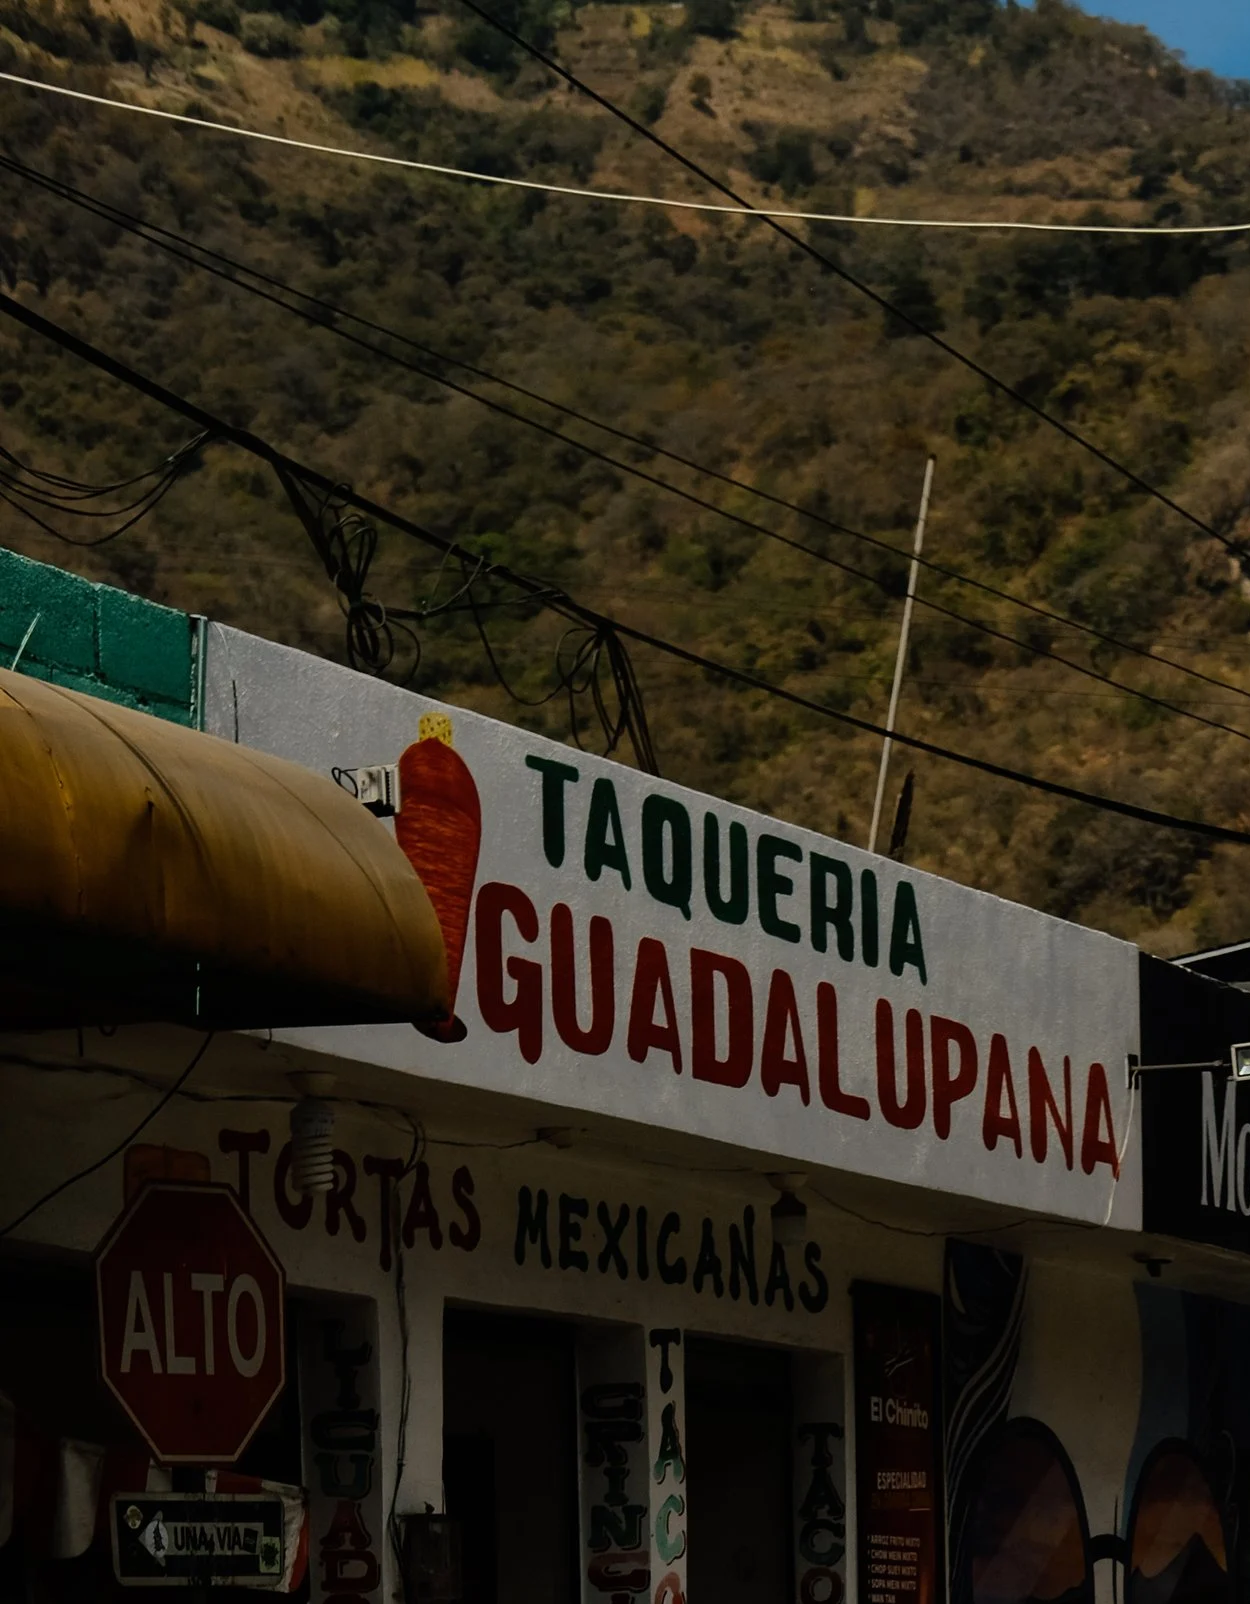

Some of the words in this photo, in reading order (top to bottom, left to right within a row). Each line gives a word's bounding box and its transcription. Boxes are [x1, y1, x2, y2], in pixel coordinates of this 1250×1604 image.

[525, 754, 927, 986] TAQUERIA
[475, 881, 1121, 1181] GUADALUPANA
[218, 1129, 481, 1272] TORTAS
[514, 1184, 829, 1314] MEXICANAS
[119, 1269, 267, 1379] ALTO
[869, 1395, 883, 1423] El
[885, 1397, 929, 1431] Chinito
[876, 1470, 927, 1490] ESPECIALIDAD
[173, 1526, 207, 1552] UNA
[216, 1526, 244, 1552] VIA
